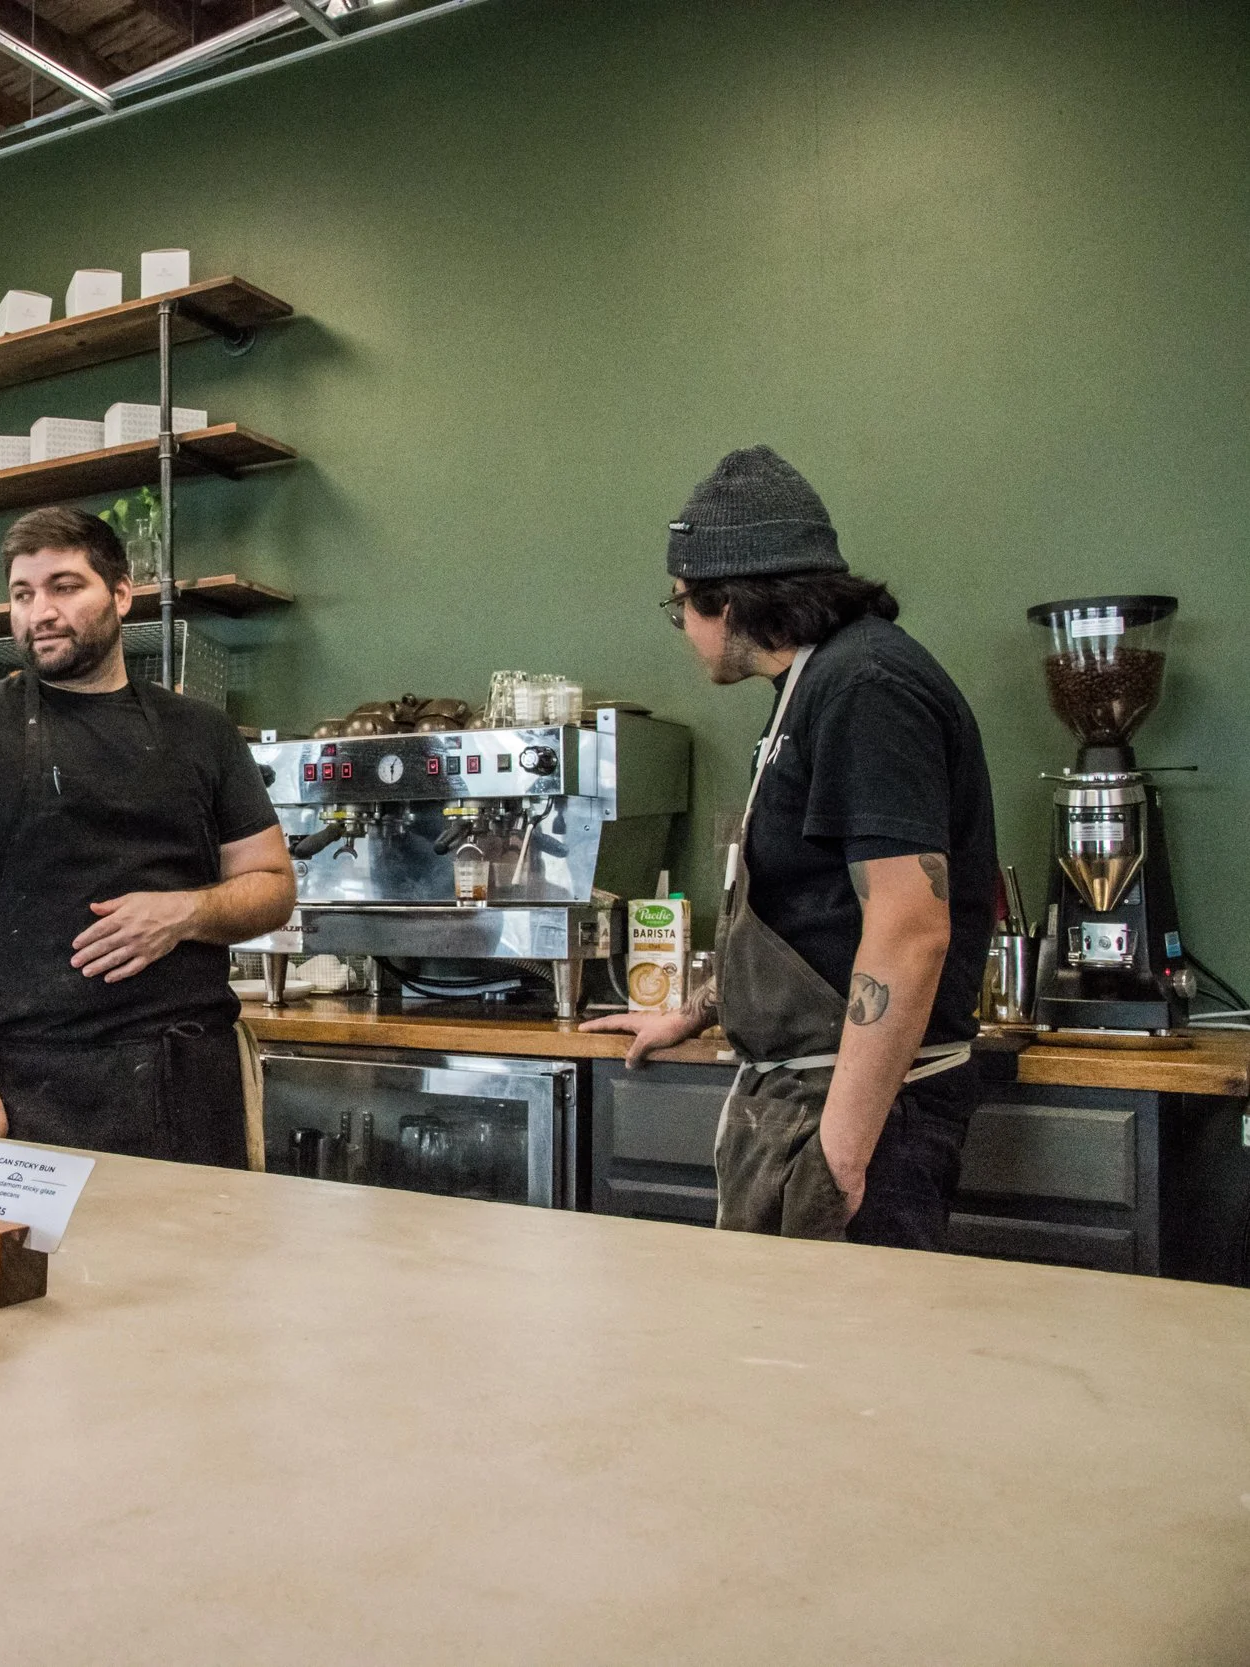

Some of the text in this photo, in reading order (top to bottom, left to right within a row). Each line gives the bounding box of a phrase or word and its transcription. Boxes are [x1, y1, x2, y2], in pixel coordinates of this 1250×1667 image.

[638, 908, 671, 920] Pacific
[633, 929, 676, 938] BARISTA
[14, 1160, 39, 1170] STICKY
[39, 1163, 56, 1173] BUN
[0, 1190, 20, 1199] pecans
[22, 1183, 38, 1194] sticky
[39, 1186, 56, 1196] glaze
